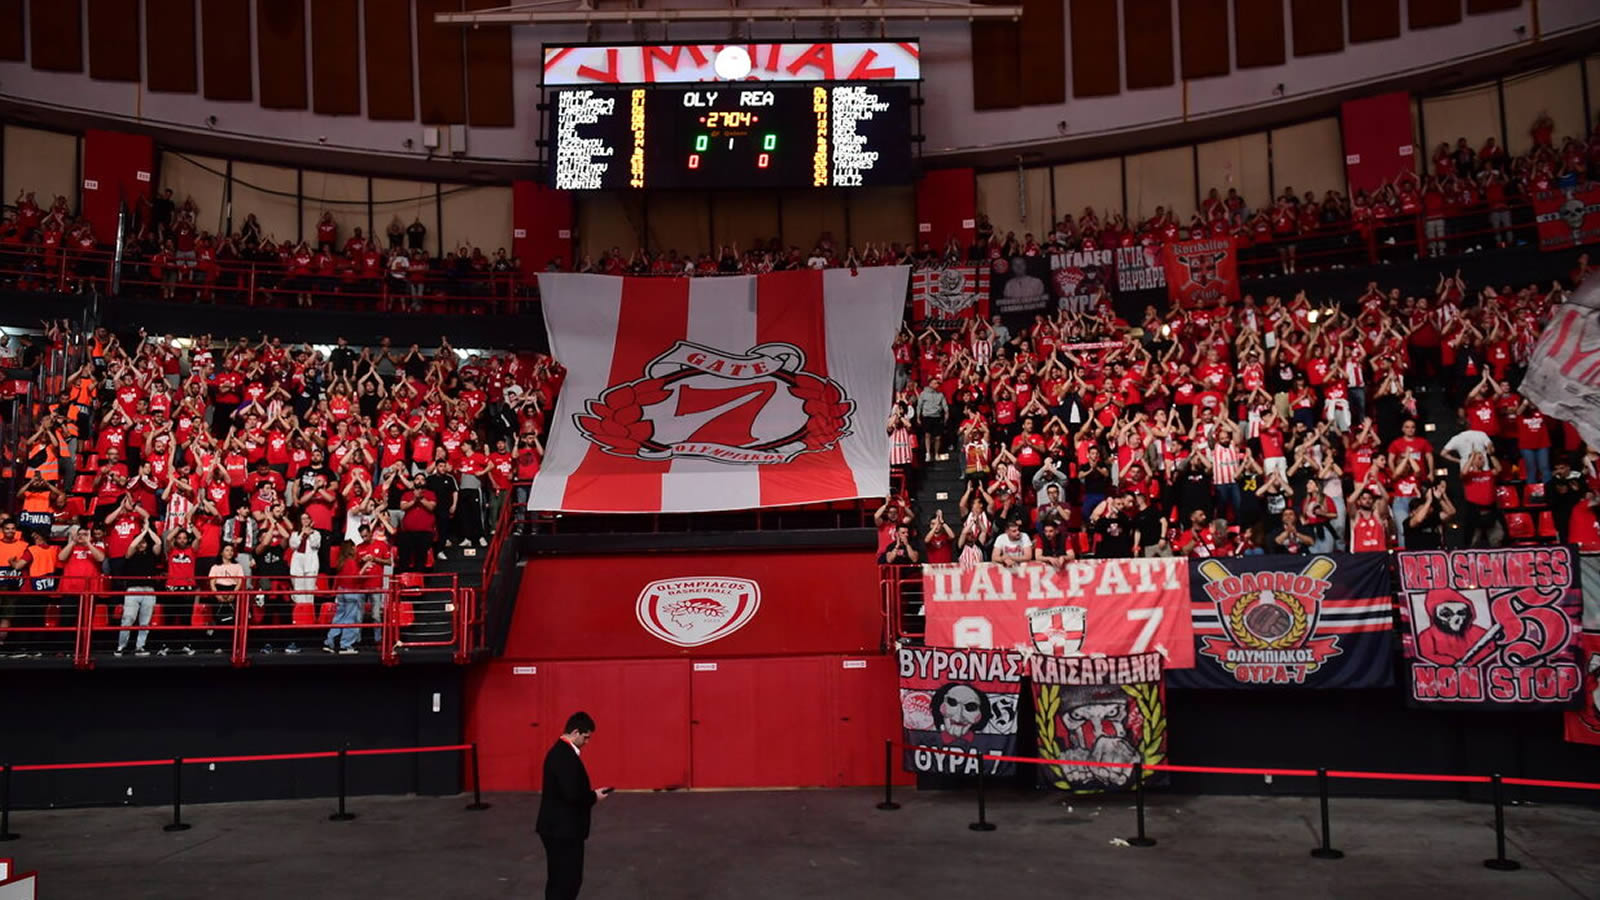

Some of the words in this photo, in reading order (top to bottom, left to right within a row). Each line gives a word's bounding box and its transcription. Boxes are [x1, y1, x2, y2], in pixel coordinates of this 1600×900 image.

[683, 91, 718, 107] OLY
[740, 91, 775, 107] REA
[695, 135, 708, 151] 0
[764, 134, 777, 151] 0
[688, 154, 700, 168] 0
[758, 154, 769, 168] 0
[1050, 250, 1113, 271] ΑΙΓΑΛΕΩ
[1117, 246, 1144, 271] ΑΓΙΑ
[1119, 267, 1166, 292] ΒΑΡΒΑΡΑ
[686, 352, 769, 377] GATE
[674, 380, 777, 447] 7
[673, 445, 787, 463] OLYMPIAKOS
[1401, 552, 1449, 590] RED
[1453, 550, 1569, 588] SICKNESS
[657, 581, 747, 592] OLYMPIACOS
[668, 588, 732, 596] BASKETBALL
[1204, 571, 1331, 601] ΚΟΛΩΝΟΣ
[1127, 608, 1163, 654] 7
[898, 649, 1021, 683] ΒΥΡΩΝΑΣ
[1226, 649, 1315, 663] ΟΛΥΜΠΙΑΚΟΣ
[1030, 654, 1161, 685] ΚΑΙΣΑΡΙΑΝΗ
[1235, 665, 1307, 683] ΘΥΡΑ-7
[1414, 666, 1482, 699] NON
[1491, 665, 1578, 699] STOP
[914, 745, 980, 775] ΘΥΡΑ
[989, 750, 1003, 775] 7
